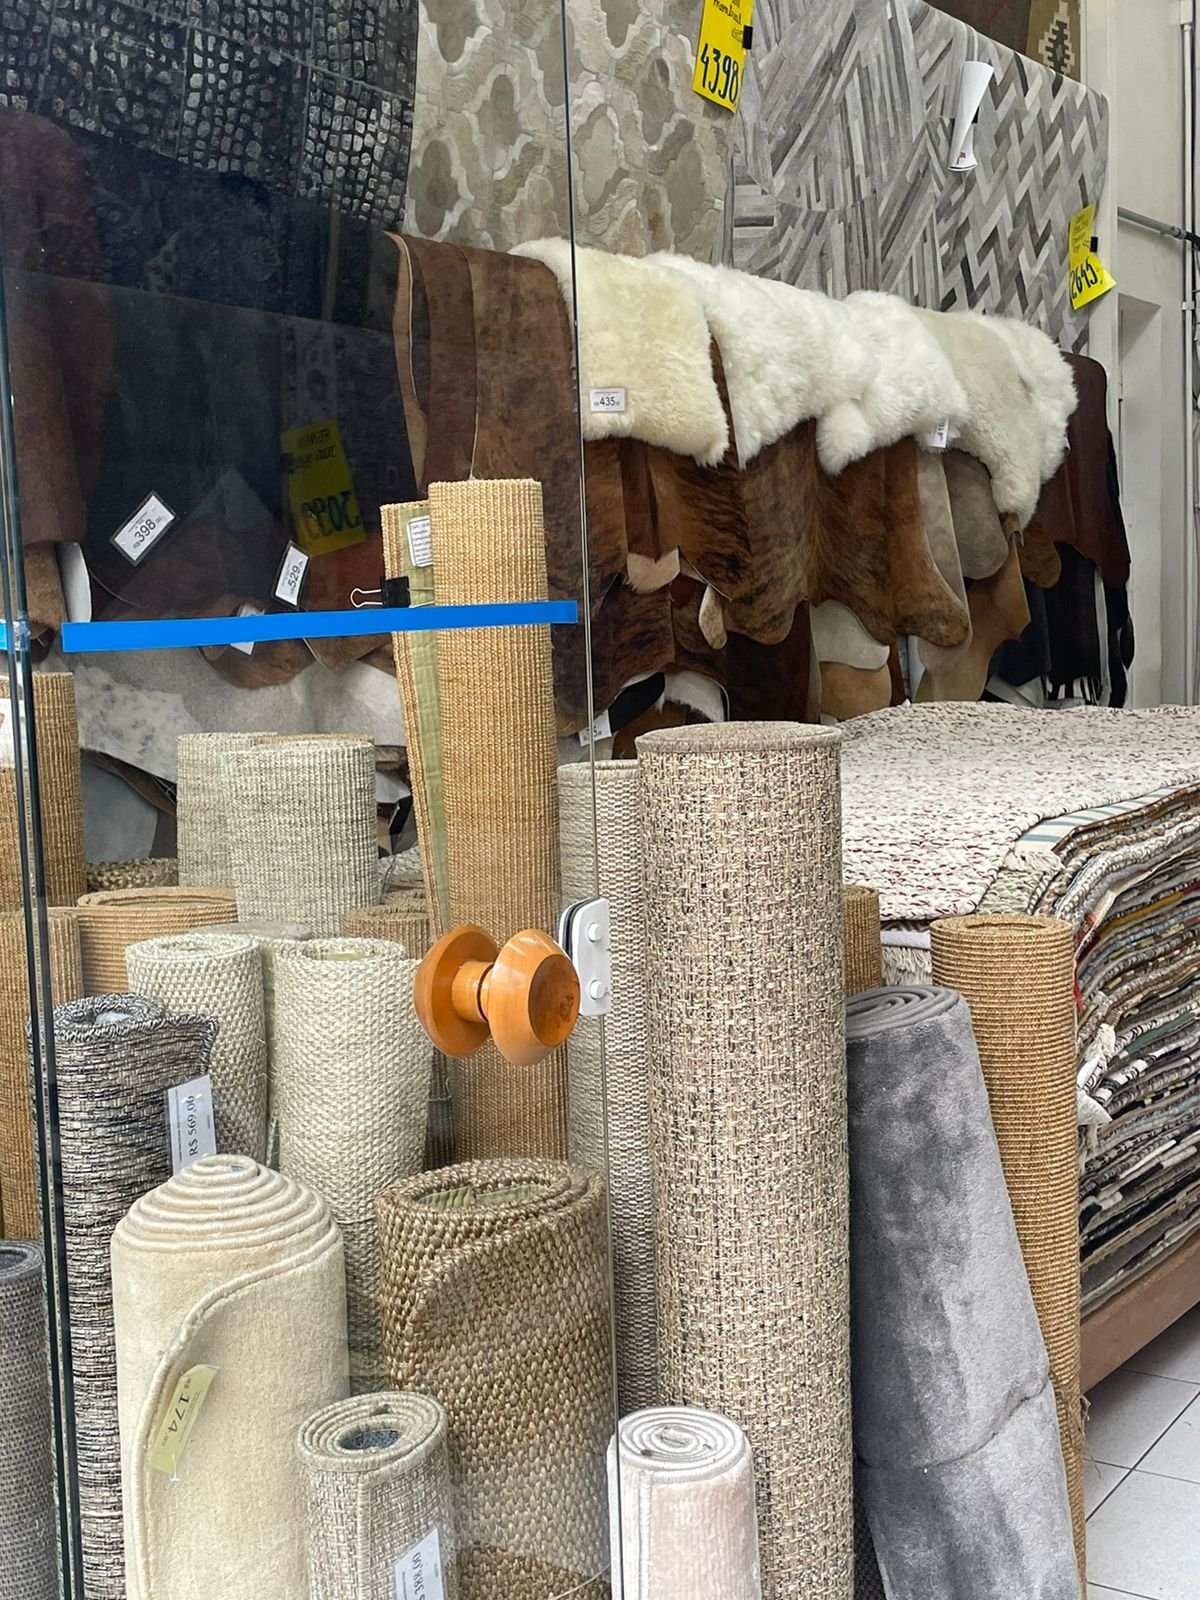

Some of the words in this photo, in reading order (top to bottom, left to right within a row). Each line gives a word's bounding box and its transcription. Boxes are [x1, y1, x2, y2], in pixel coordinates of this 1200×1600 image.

[600, 396, 616, 407] 435
[134, 519, 156, 543] 398
[288, 565, 301, 588] 529
[186, 1095, 198, 1136] 569,00
